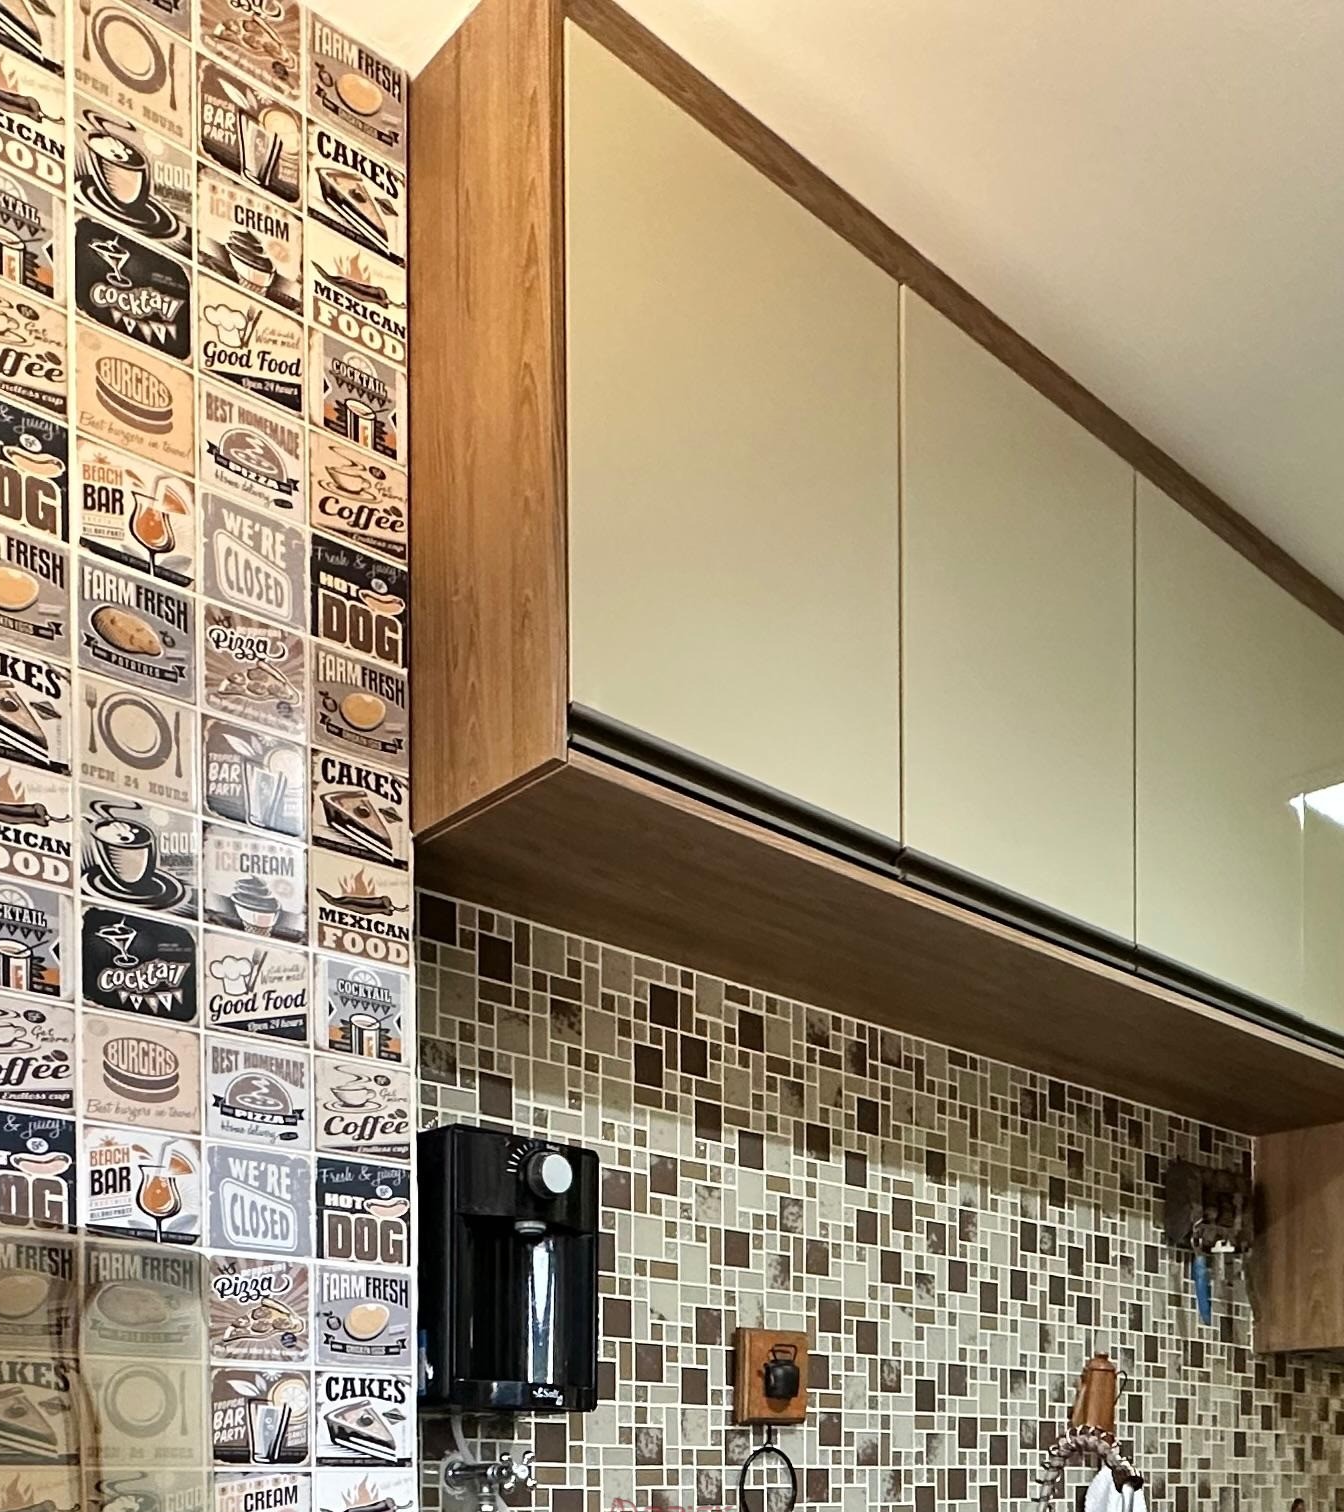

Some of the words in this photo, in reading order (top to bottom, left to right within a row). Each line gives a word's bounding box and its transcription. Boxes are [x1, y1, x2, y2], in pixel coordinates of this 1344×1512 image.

[318, 131, 400, 200] CAKES
[314, 280, 407, 340] MEXICAN
[318, 303, 405, 358] FOOD
[204, 340, 254, 377] Good
[257, 353, 301, 377] Food
[100, 355, 170, 407] BURGERS
[82, 486, 123, 515] BAR
[319, 571, 360, 594] HOT
[210, 626, 285, 660] Pizza
[321, 593, 401, 662] DOG
[322, 757, 402, 803] CAKES
[322, 924, 408, 963] FOOD
[230, 1159, 289, 1193] WE'RE
[229, 1191, 291, 1240] CLOSED
[325, 1193, 365, 1209] HOT
[326, 1218, 405, 1262] DOG
[326, 1377, 405, 1403] CAKES
